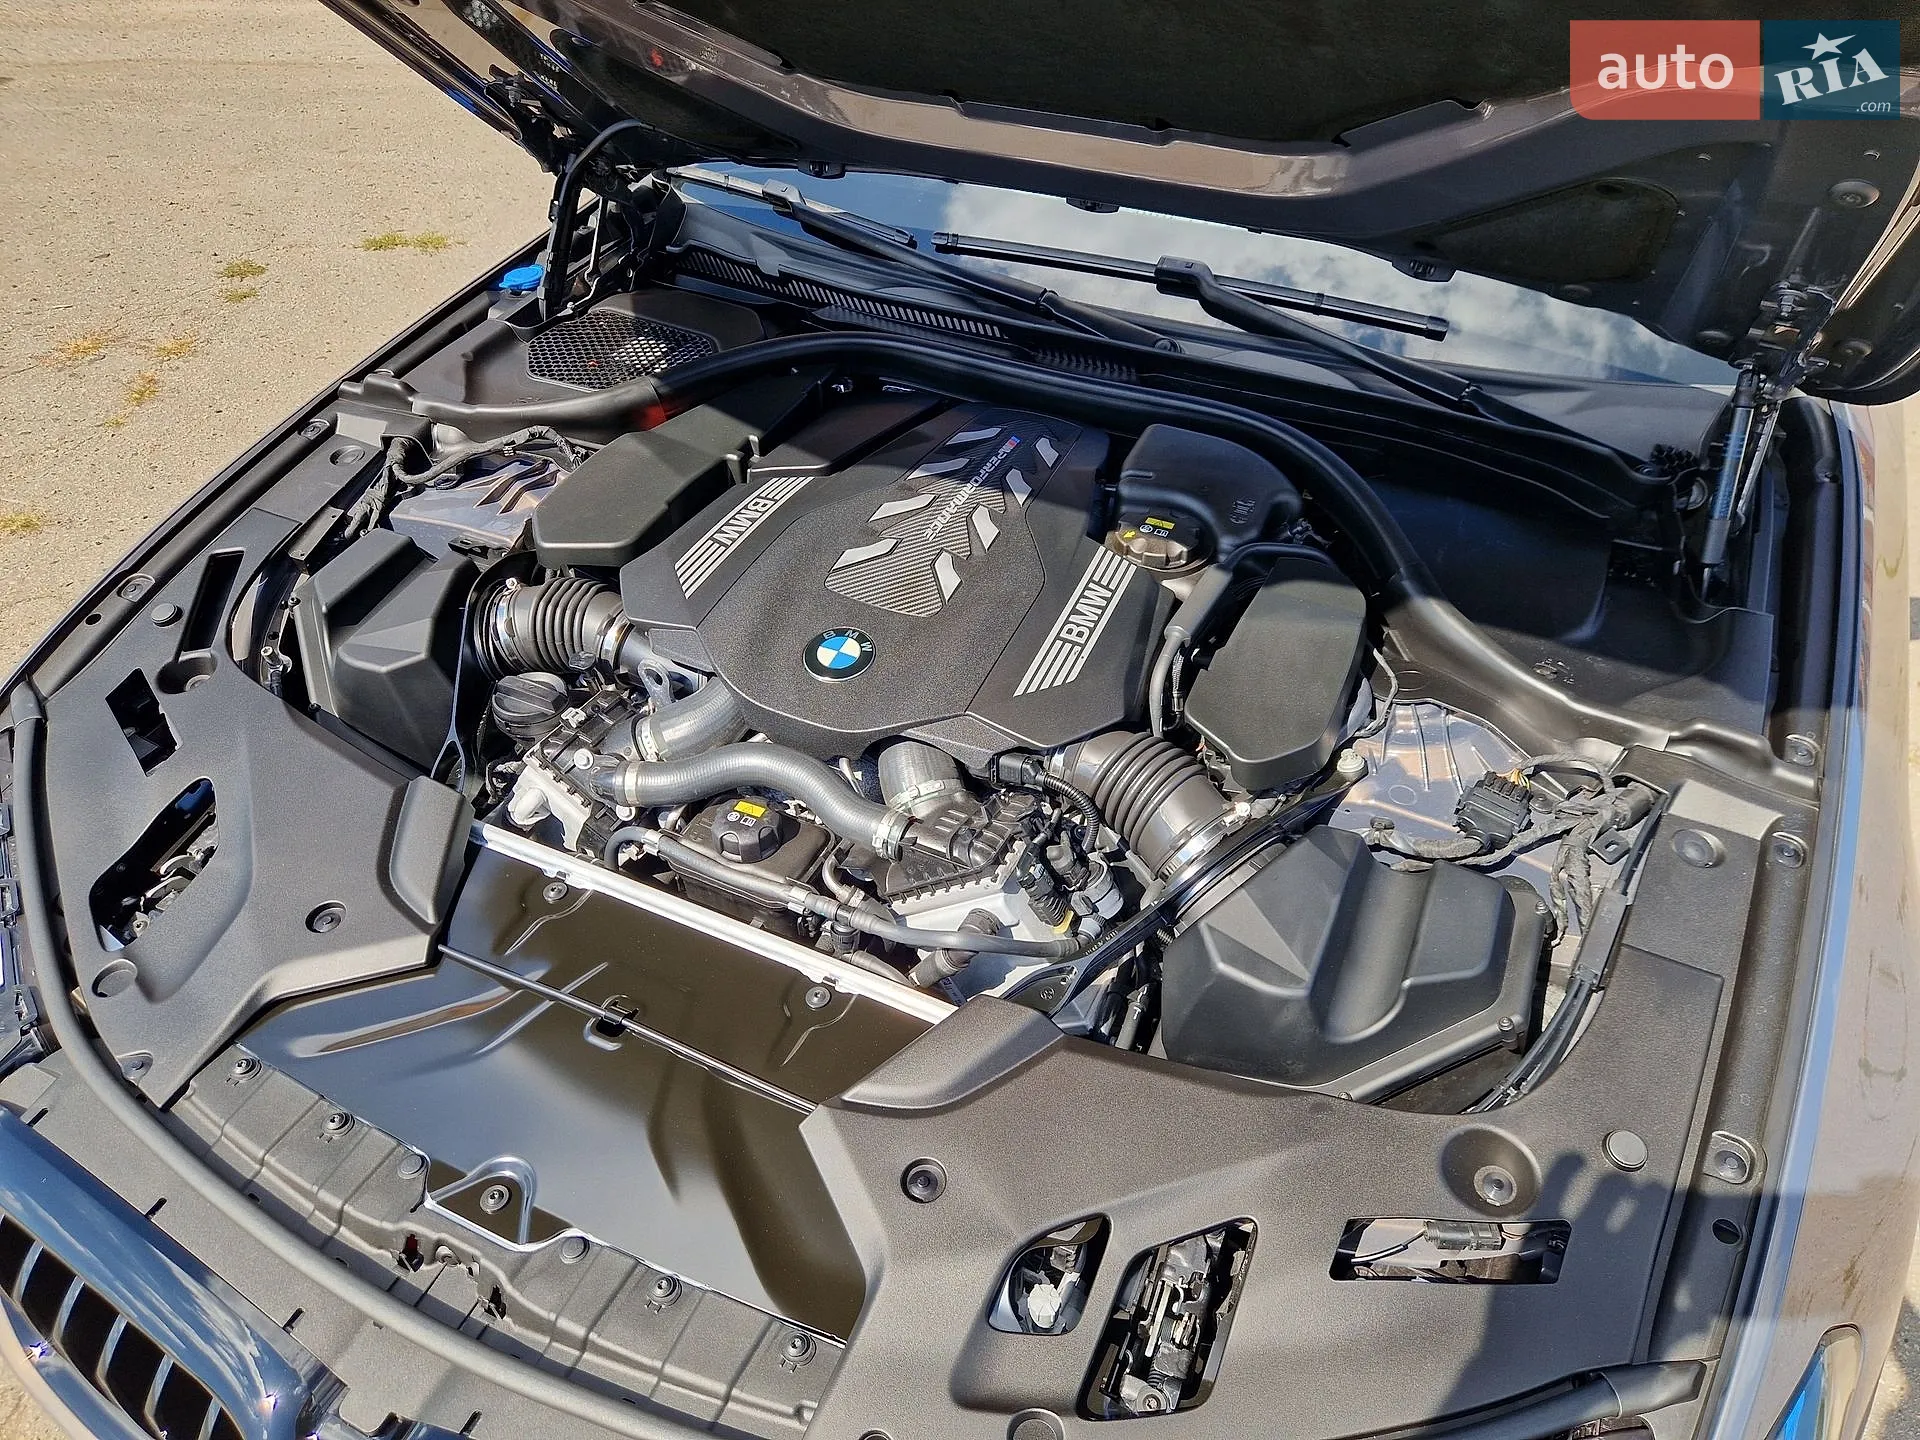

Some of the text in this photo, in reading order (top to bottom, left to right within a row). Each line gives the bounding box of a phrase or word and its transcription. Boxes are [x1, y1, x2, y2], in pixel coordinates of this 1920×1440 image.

[712, 497, 776, 546] BMW
[1059, 583, 1113, 644] BMW
[822, 629, 873, 652] BMW
